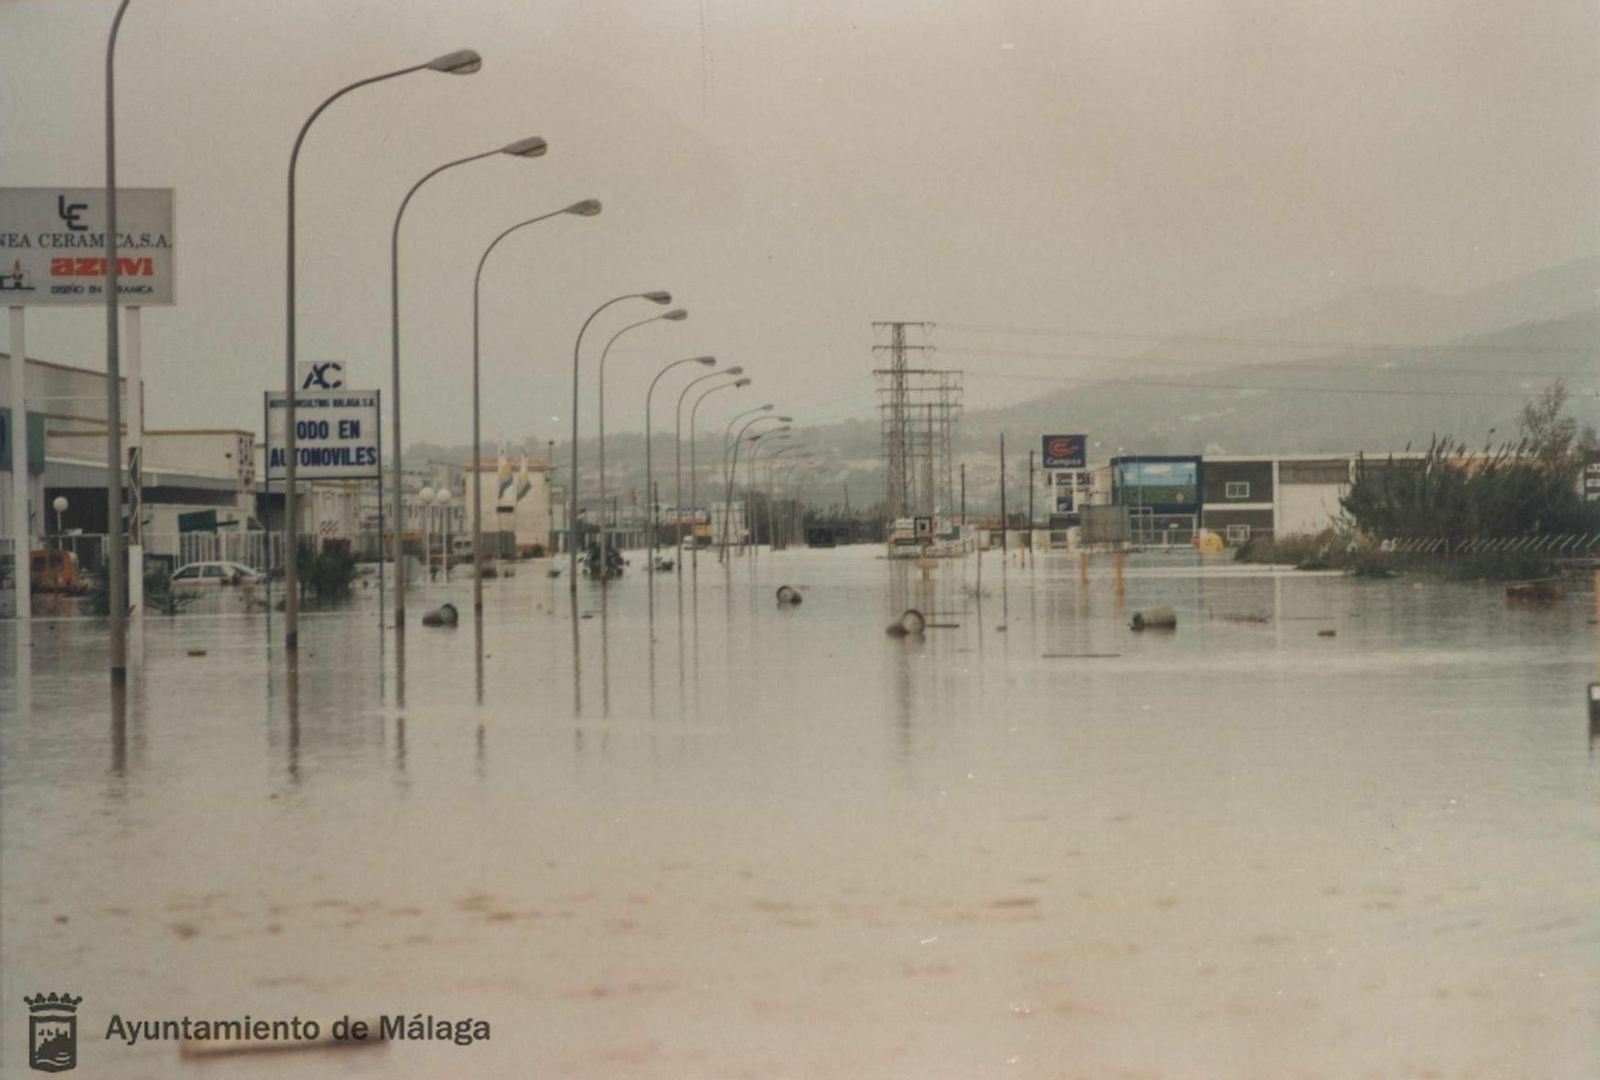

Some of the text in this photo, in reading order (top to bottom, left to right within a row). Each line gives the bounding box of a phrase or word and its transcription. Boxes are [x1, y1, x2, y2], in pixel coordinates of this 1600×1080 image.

[38, 233, 173, 249] CERAMCA,S.A.
[297, 420, 360, 440] ODO EN
